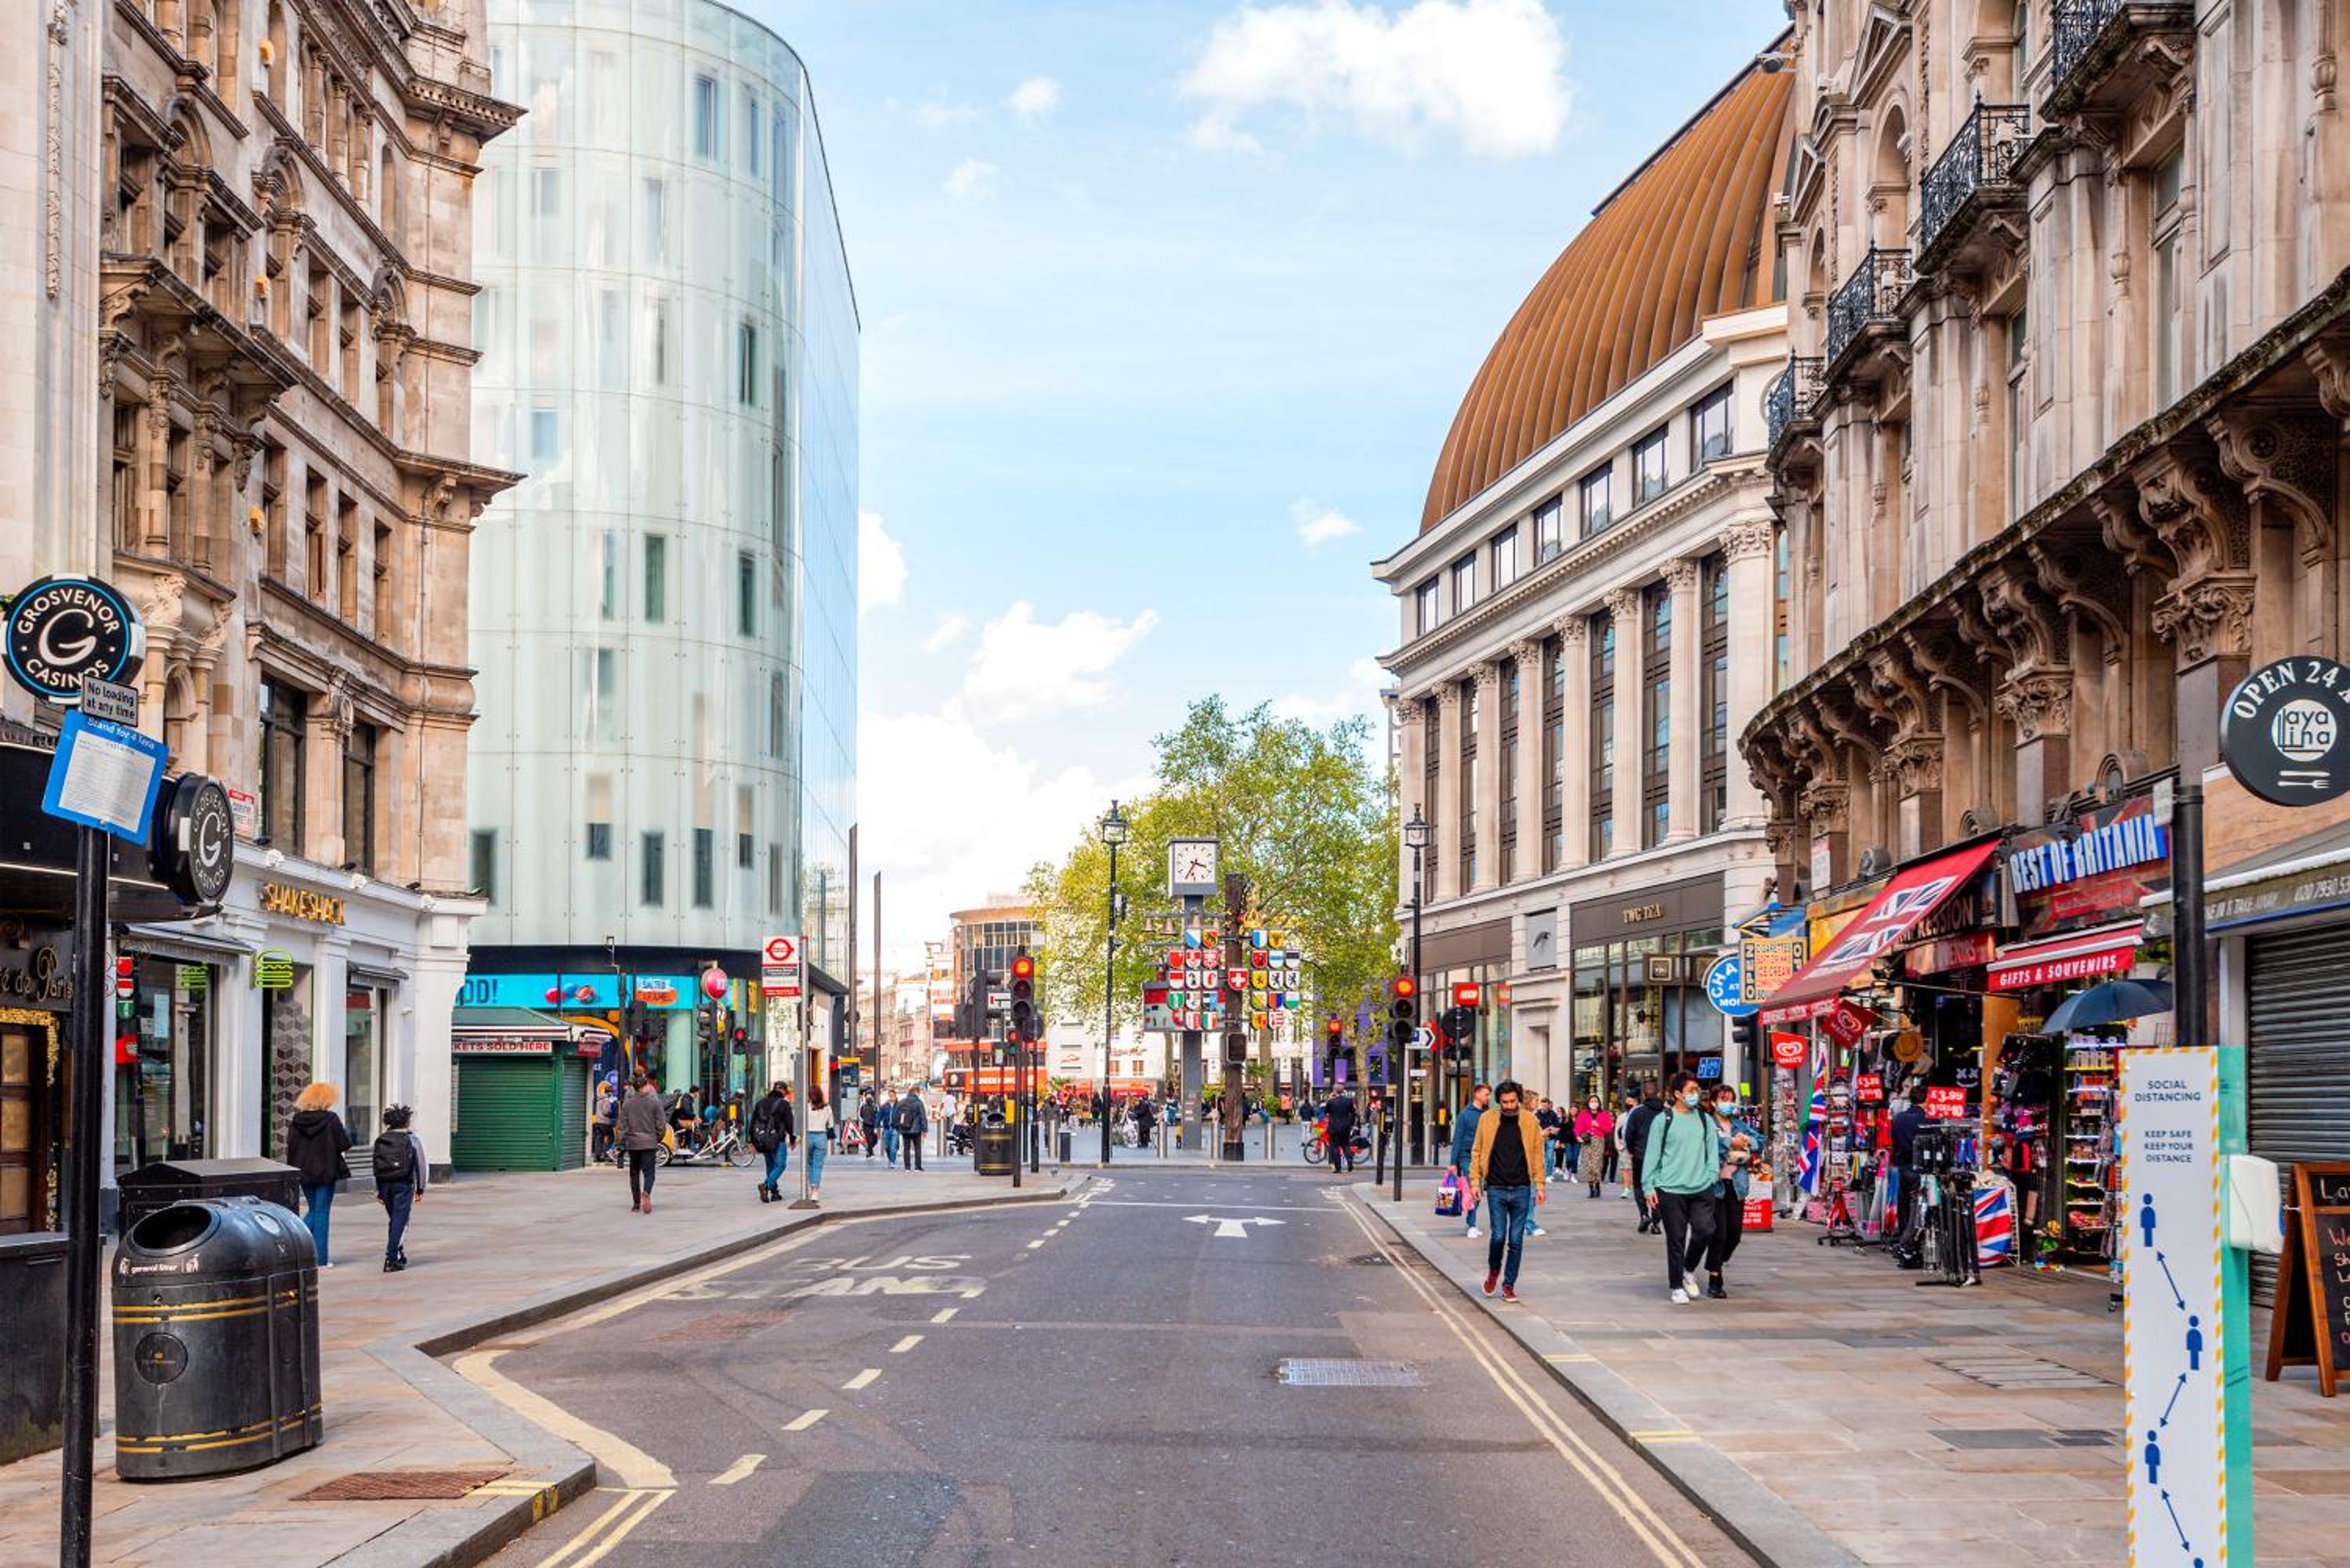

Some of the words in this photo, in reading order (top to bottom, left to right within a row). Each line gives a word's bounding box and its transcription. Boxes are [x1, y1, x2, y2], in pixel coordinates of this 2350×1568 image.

[18, 589, 120, 634] GROSVENOR
[27, 659, 109, 688] CASINOS
[88, 683, 101, 696] No
[102, 686, 135, 706] loading
[2234, 663, 2296, 718] OPEN
[2306, 661, 2339, 688] 24
[86, 698, 96, 710] at
[98, 701, 114, 716] any
[117, 704, 136, 719] time
[88, 717, 115, 733] Stand
[117, 727, 130, 739] for
[194, 792, 230, 838] GROSVENOR
[2009, 847, 2048, 894] BEST
[2050, 840, 2074, 886] OF
[2073, 815, 2159, 878] BRITANIA
[195, 858, 225, 890] CASINOS
[1623, 907, 1642, 923] TWG
[1644, 903, 1663, 919] TEA
[15, 969, 32, 993] de
[37, 947, 74, 1003] Paris
[1744, 942, 1755, 1001] OPEN
[2000, 970, 2031, 987] GIFTS
[2035, 968, 2044, 981] &
[2048, 954, 2117, 978] SOUVENIRS
[486, 1041, 517, 1051] SOLD
[520, 1041, 550, 1051] HERE
[2147, 1079, 2187, 1089] SOCIAL
[1930, 1089, 1964, 1103] £3.99
[2135, 1092, 2201, 1102] DISTANCING
[1929, 1104, 1936, 1116] 3
[2146, 1154, 2193, 1163] DISTANCE
[131, 1263, 157, 1274] general
[159, 1263, 178, 1272] litter
[787, 1255, 971, 1270] BUS
